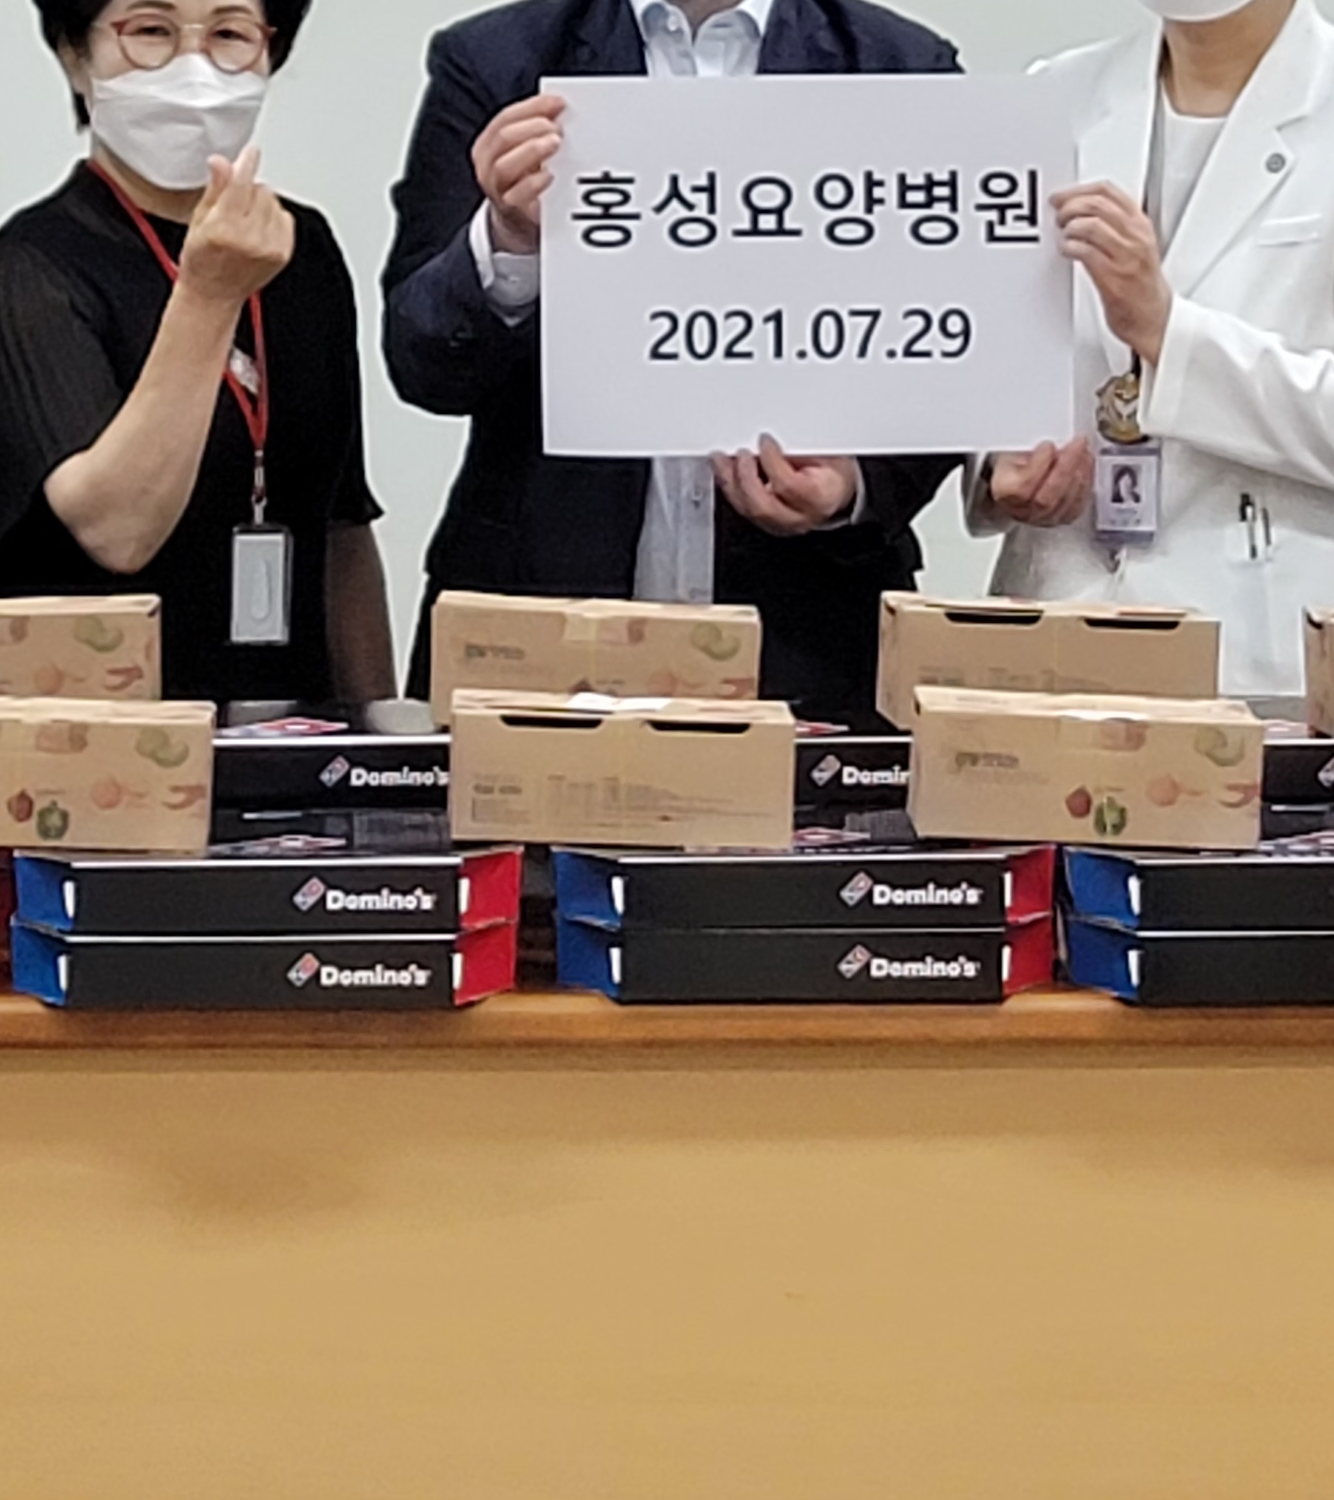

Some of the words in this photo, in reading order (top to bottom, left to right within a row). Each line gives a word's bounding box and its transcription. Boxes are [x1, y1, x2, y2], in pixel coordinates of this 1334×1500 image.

[570, 168, 1041, 248] 홍성요양병원
[648, 307, 972, 361] 2021.07.29
[350, 765, 449, 788] Domino's
[326, 887, 436, 911] Domino's
[872, 882, 982, 905] Domino's
[320, 963, 431, 987] Domino's
[870, 955, 981, 978] Domino's
